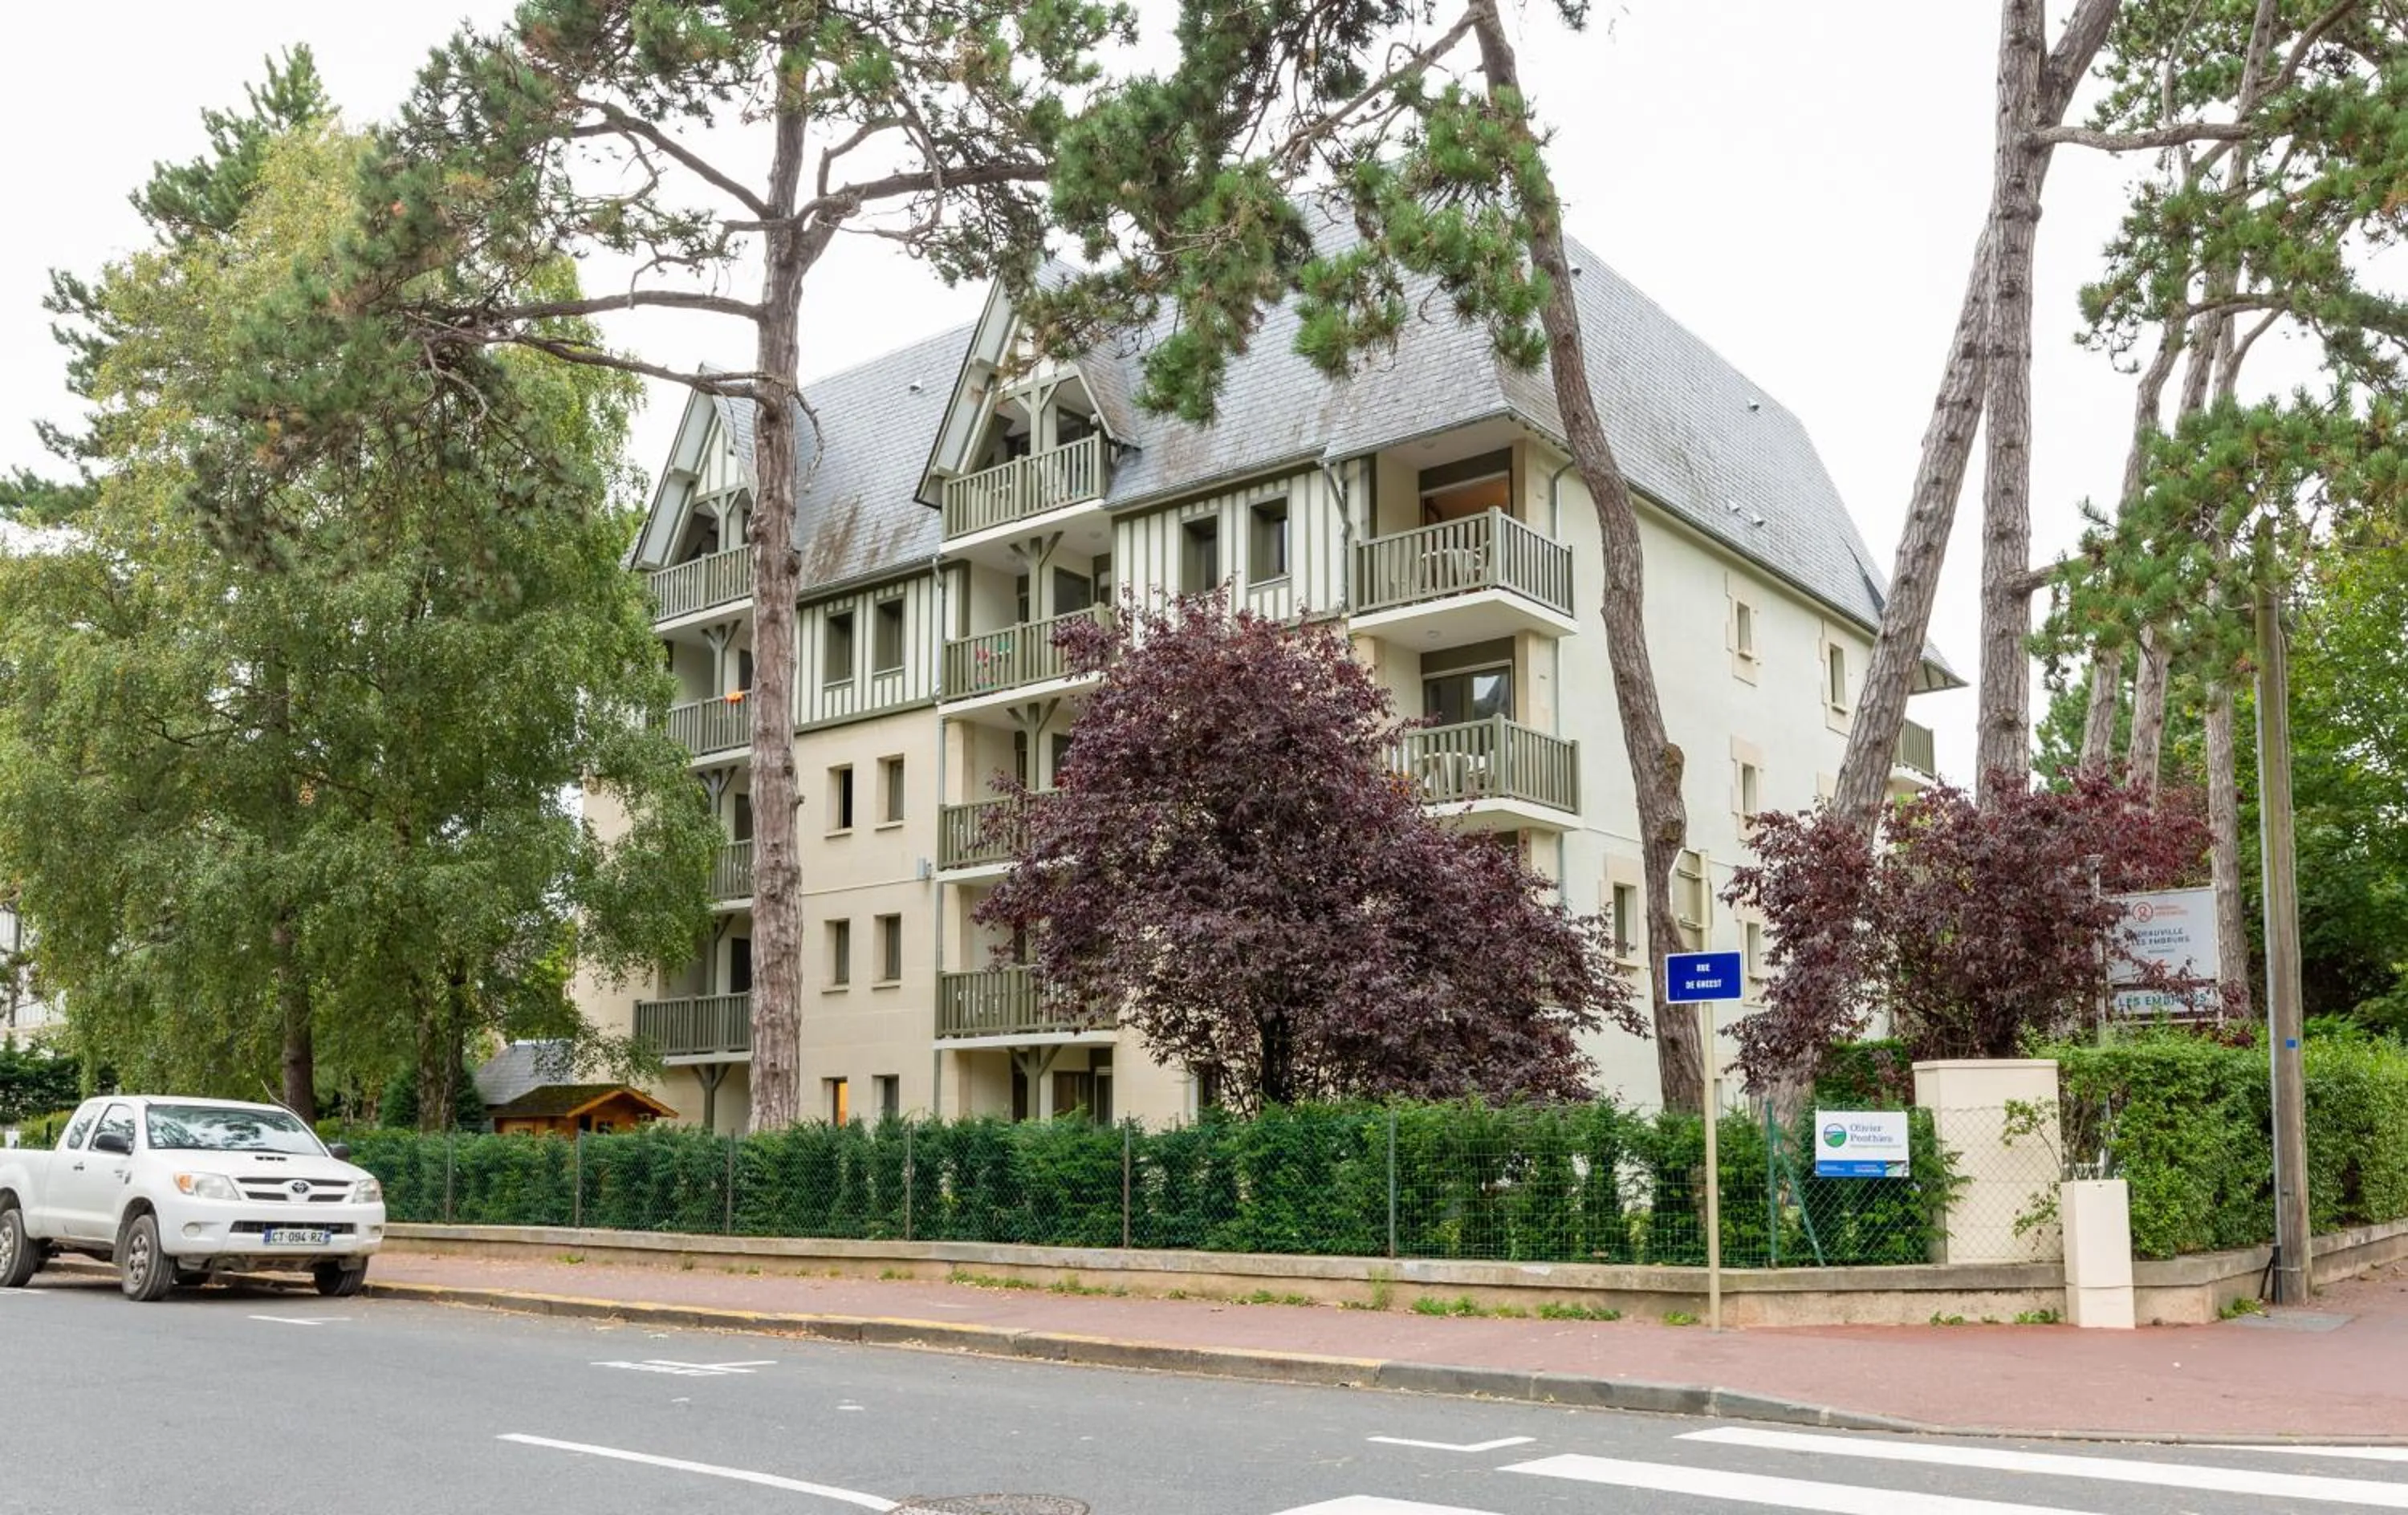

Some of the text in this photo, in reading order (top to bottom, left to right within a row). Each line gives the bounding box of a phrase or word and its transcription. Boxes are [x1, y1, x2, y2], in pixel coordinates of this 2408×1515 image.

[1696, 963, 1710, 972] RUE
[1685, 981, 1694, 989] DE
[2117, 994, 2141, 1008] LES
[1849, 1123, 1883, 1132] Olivier
